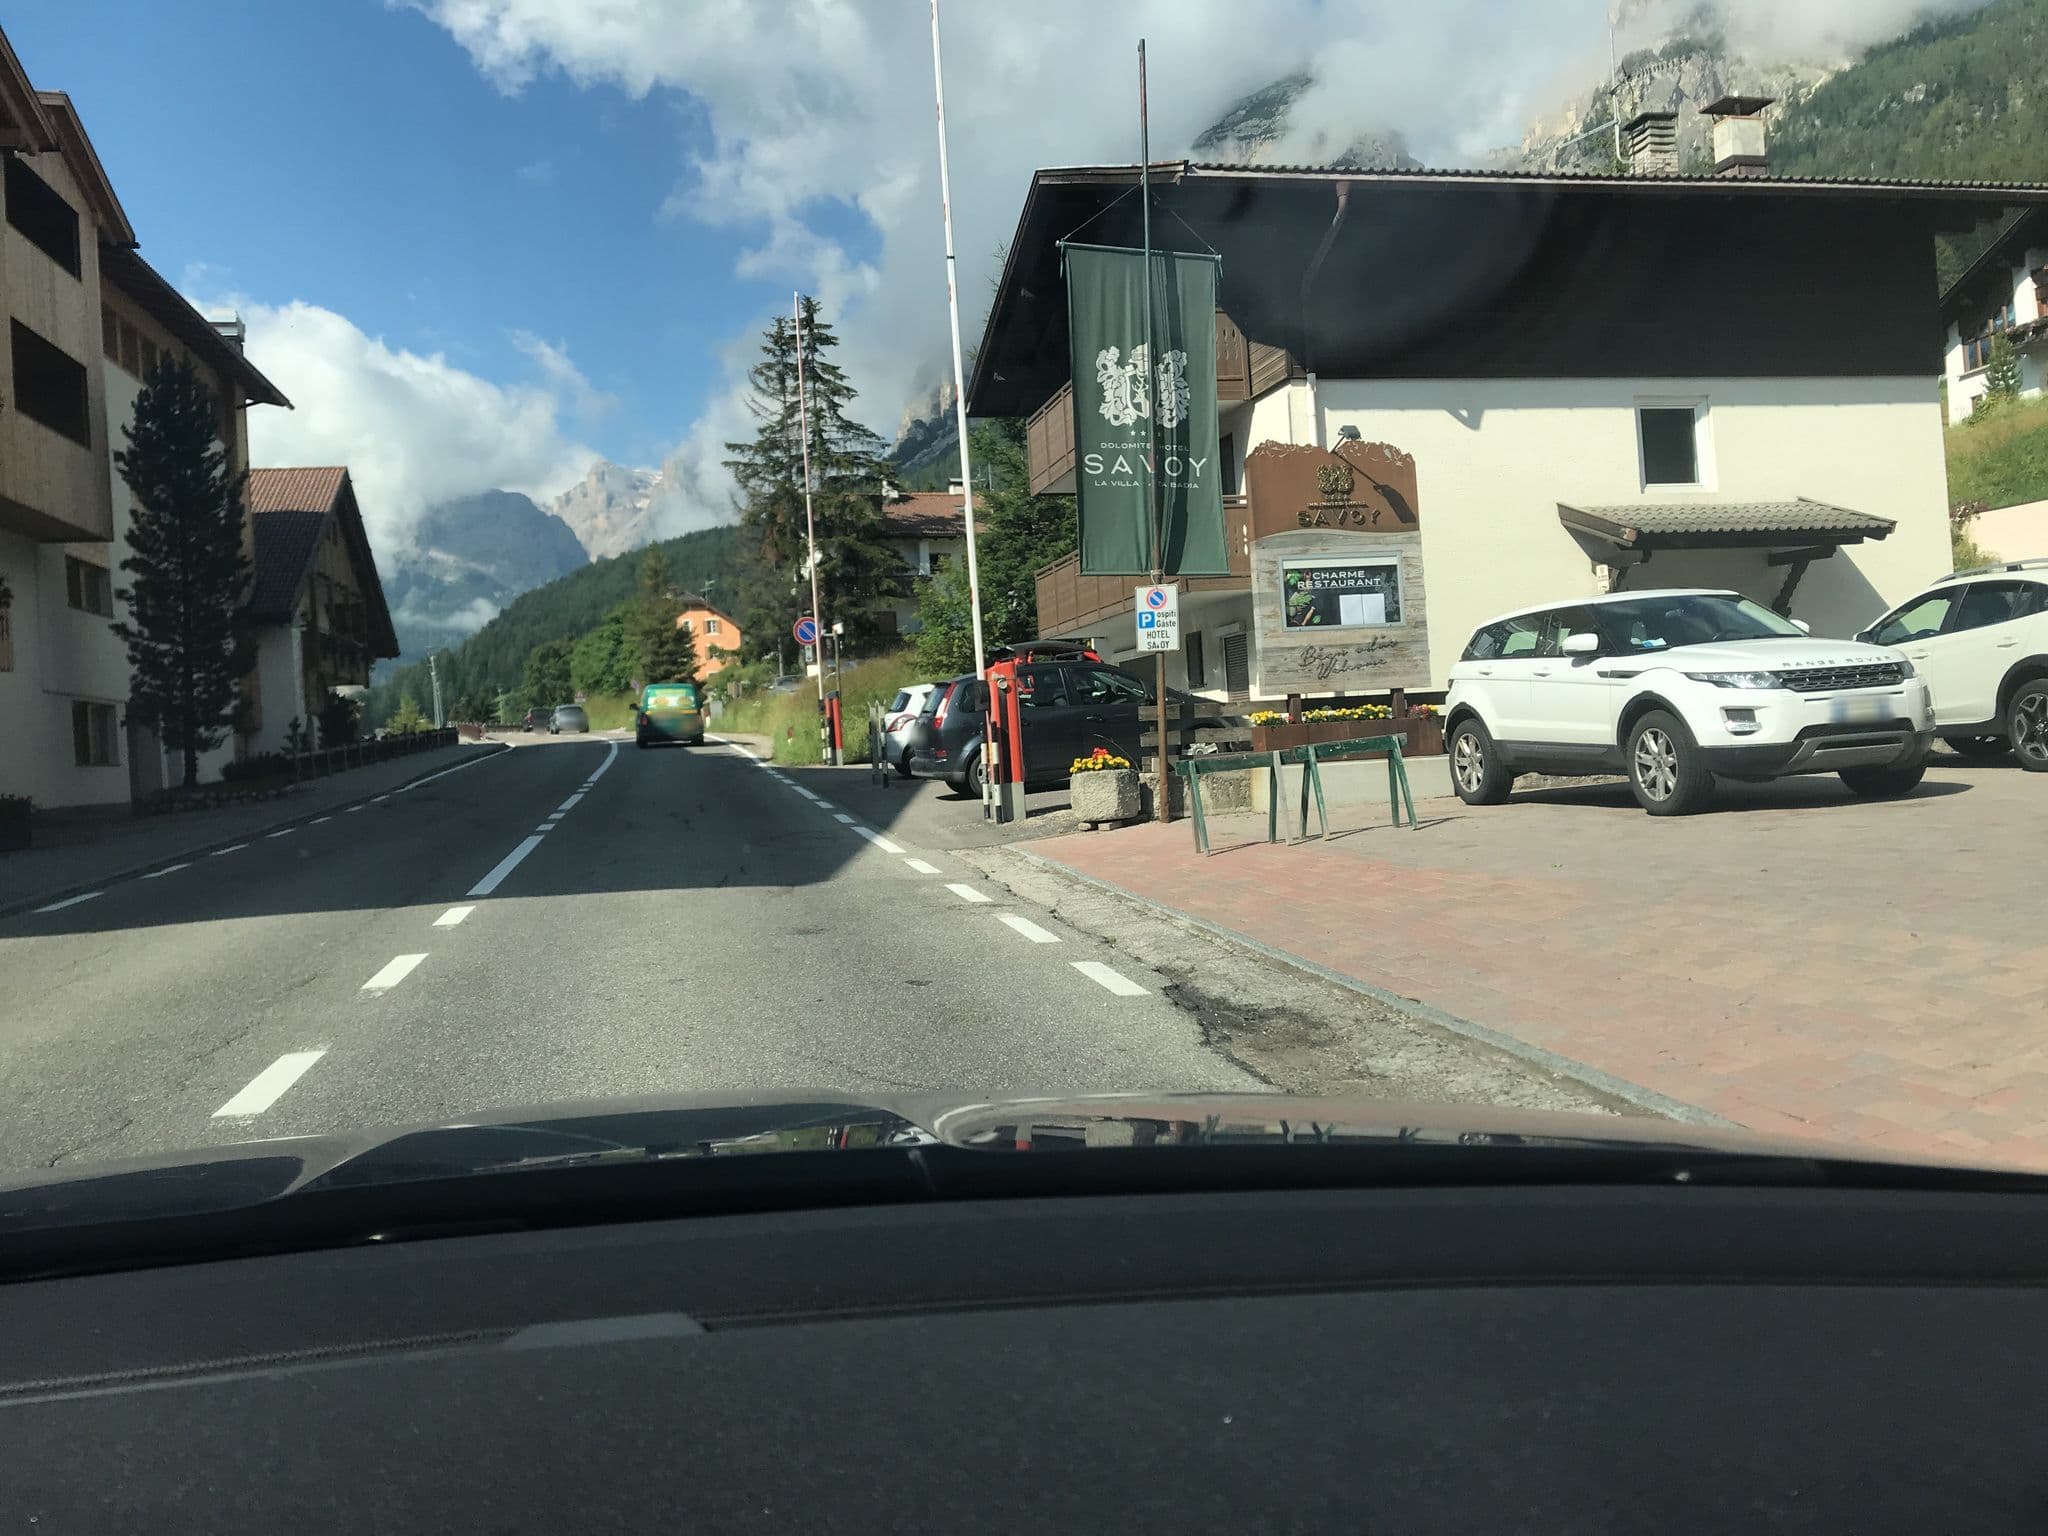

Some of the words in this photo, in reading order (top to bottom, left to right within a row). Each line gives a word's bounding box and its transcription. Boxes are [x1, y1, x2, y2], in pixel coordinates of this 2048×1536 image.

[1110, 480, 1140, 488] VILLA
[1312, 570, 1366, 580] CHARME
[1297, 578, 1381, 589] RESTAURANT
[1146, 630, 1170, 640] HOTEL
[1782, 659, 1836, 667] RANGE
